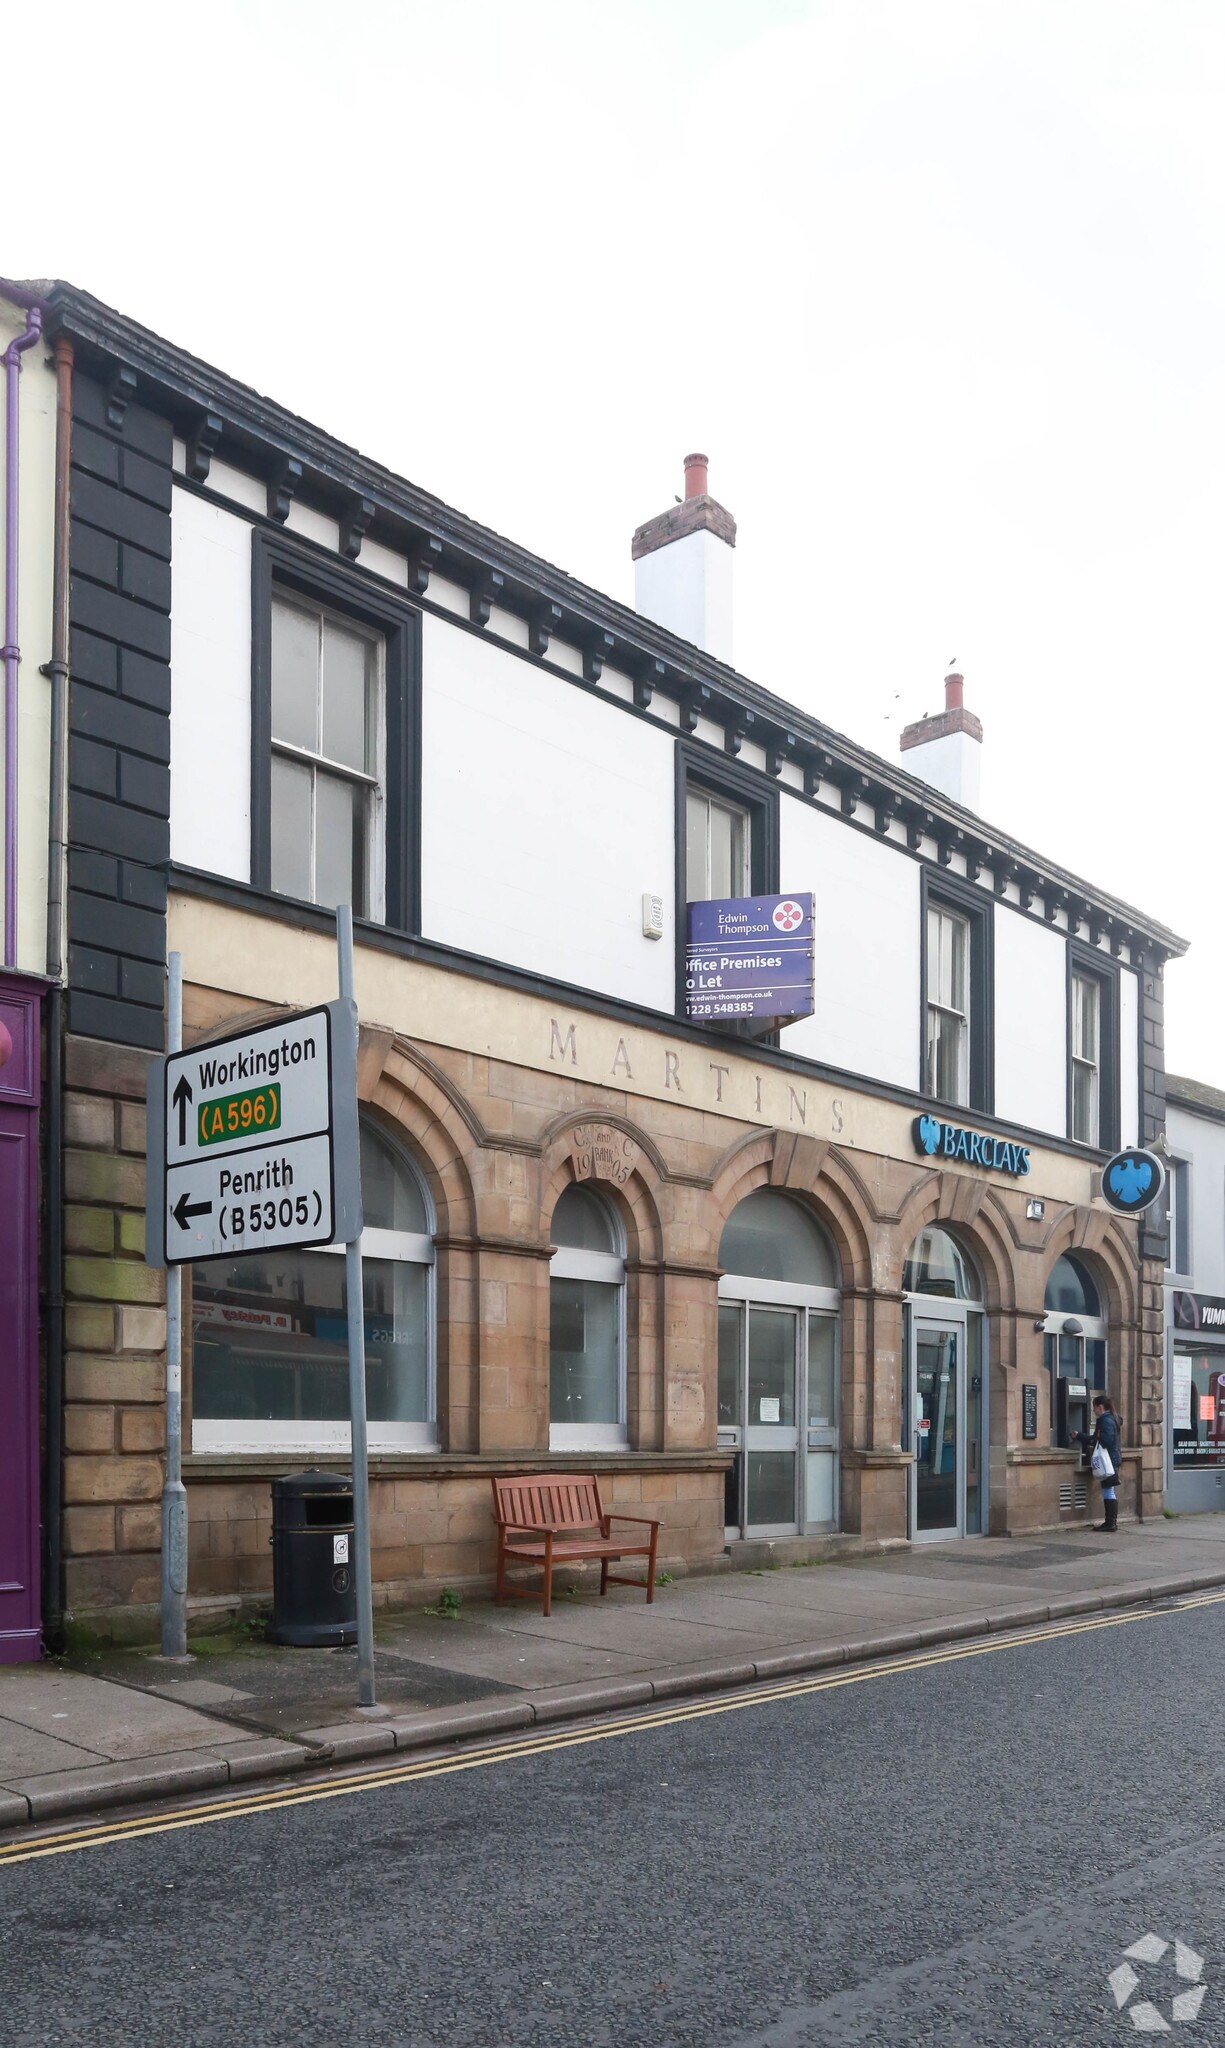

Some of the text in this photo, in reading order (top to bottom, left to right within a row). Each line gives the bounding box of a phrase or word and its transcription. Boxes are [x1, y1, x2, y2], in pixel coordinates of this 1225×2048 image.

[718, 913, 748, 924] Edwin
[718, 924, 769, 936] Thompson
[720, 955, 782, 970] Premises
[686, 975, 722, 989] o Let
[685, 1002, 754, 1015] 1228 548385
[199, 1037, 316, 1090] Workington
[549, 1018, 843, 1134] MARTINS
[201, 1088, 278, 1141] (A596)
[595, 1147, 614, 1164] BANK
[942, 1124, 1031, 1176] BARCLAYS
[220, 1158, 294, 1198] Penrith
[219, 1189, 322, 1240] (B5305)
